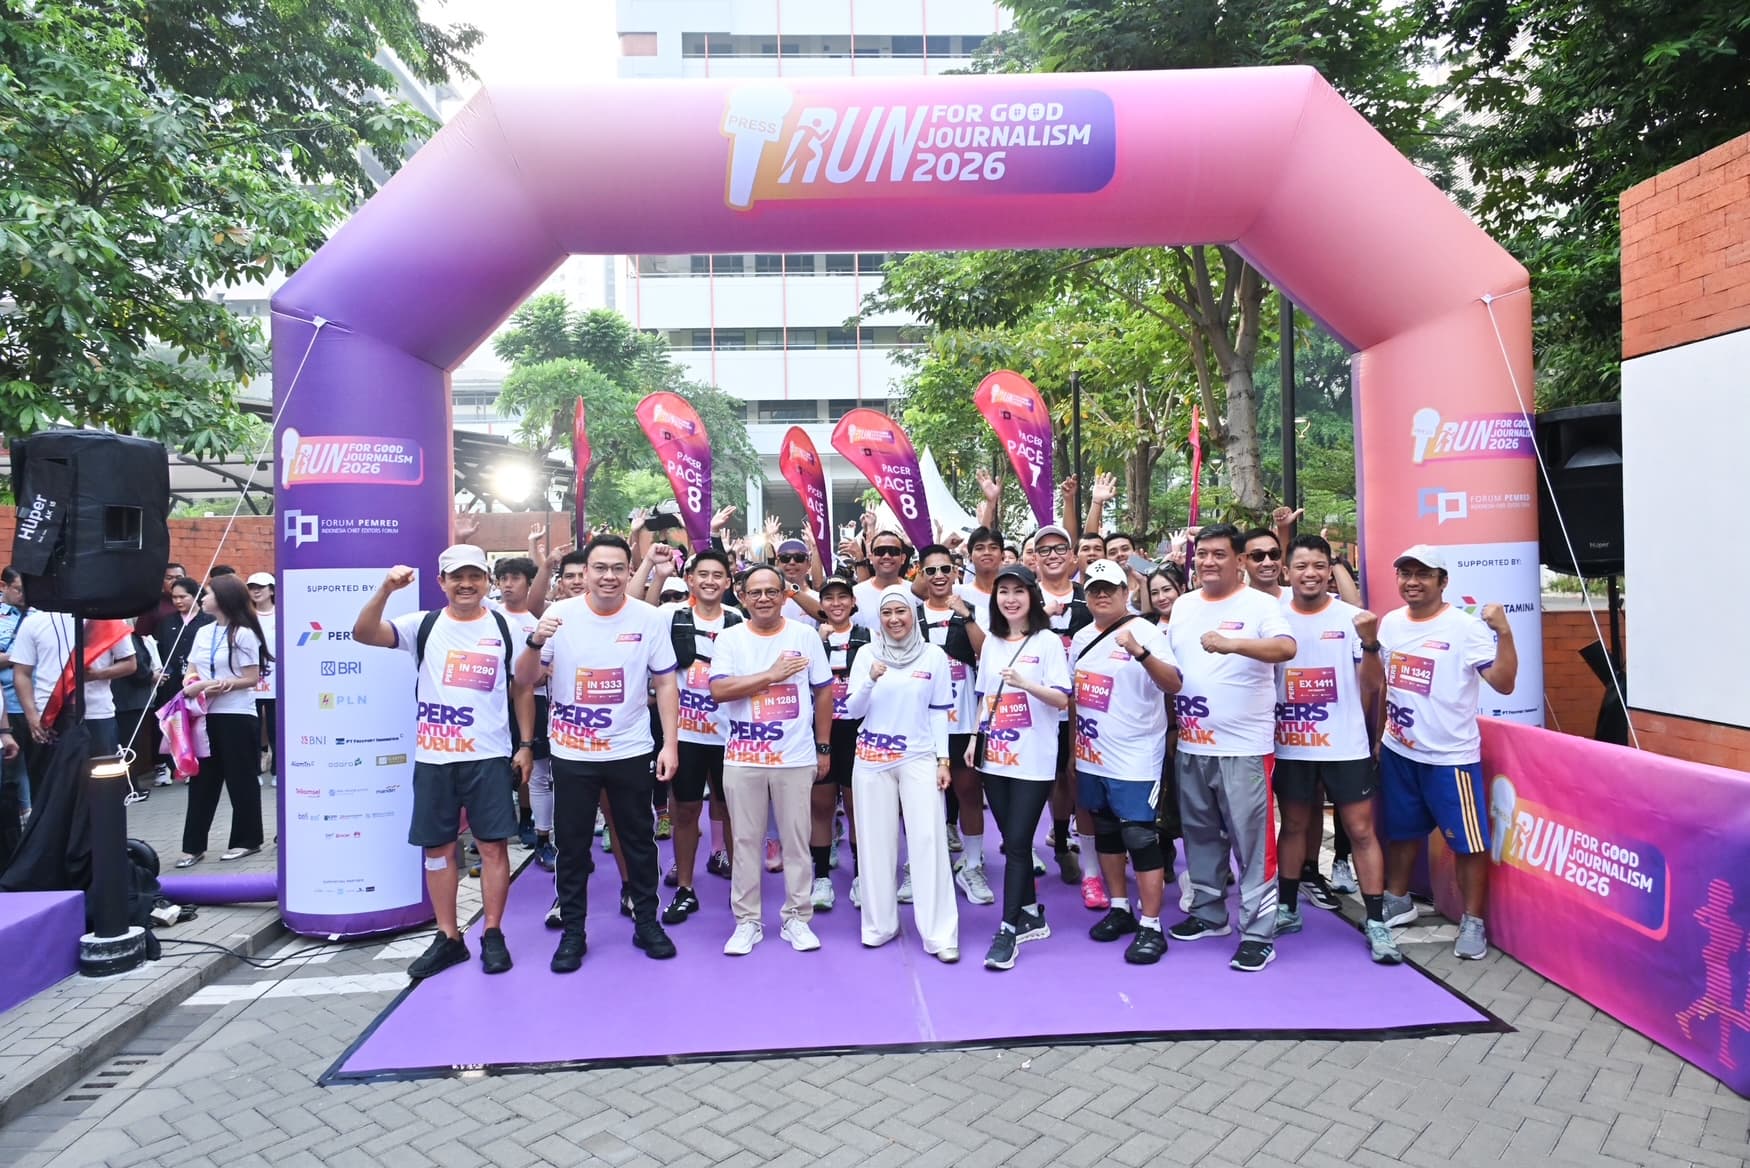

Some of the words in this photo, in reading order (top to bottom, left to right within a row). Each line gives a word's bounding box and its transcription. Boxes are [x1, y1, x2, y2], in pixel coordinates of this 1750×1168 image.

[932, 104, 982, 123] FOR
[990, 102, 1064, 122] GOOD
[727, 114, 777, 135] PRESS
[777, 106, 929, 183] RUN
[917, 124, 1092, 148] JOURNALISM
[912, 151, 1006, 181] 2026
[1495, 419, 1512, 428] FOR
[1435, 419, 1495, 453] RUN
[1489, 438, 1519, 449] 2026
[343, 452, 413, 464] JOURNALISM
[348, 443, 372, 452] FOR
[373, 444, 404, 454] GOOD
[1007, 440, 1044, 465] PACE
[293, 443, 349, 475] RUN
[341, 463, 381, 474] 2026
[667, 460, 703, 488] PACE
[881, 463, 911, 476] PACER
[874, 474, 915, 493] PACE
[687, 486, 702, 513] 8
[899, 493, 918, 520] 8
[18, 494, 47, 541] Huper
[1457, 559, 1510, 567] SUPPORTED
[338, 661, 362, 674] BRI
[459, 663, 470, 672] IN
[471, 664, 495, 676] 1290
[1401, 664, 1410, 675] IN
[1411, 667, 1431, 680] 1342
[587, 680, 598, 689] IN
[599, 680, 623, 689] 1333
[1082, 683, 1090, 691] IN
[1091, 684, 1110, 697] 1004
[1299, 679, 1312, 688] EX
[1313, 679, 1334, 688] 1411
[336, 696, 367, 704] PLN
[679, 689, 719, 712] ERS
[764, 697, 775, 706] IN
[999, 704, 1008, 713] IN
[1009, 703, 1027, 713] 1051
[416, 702, 474, 727] PERS
[677, 717, 718, 735] UBLIK
[729, 719, 784, 741] PERS
[1276, 721, 1318, 733] NTUK
[309, 736, 327, 744] BNI
[1510, 810, 1575, 878] RUN
[1573, 831, 1600, 852] FOR
[1601, 841, 1640, 868] GOOD
[1565, 863, 1611, 898] 2026
[1568, 848, 1653, 894] JOURNALISM
